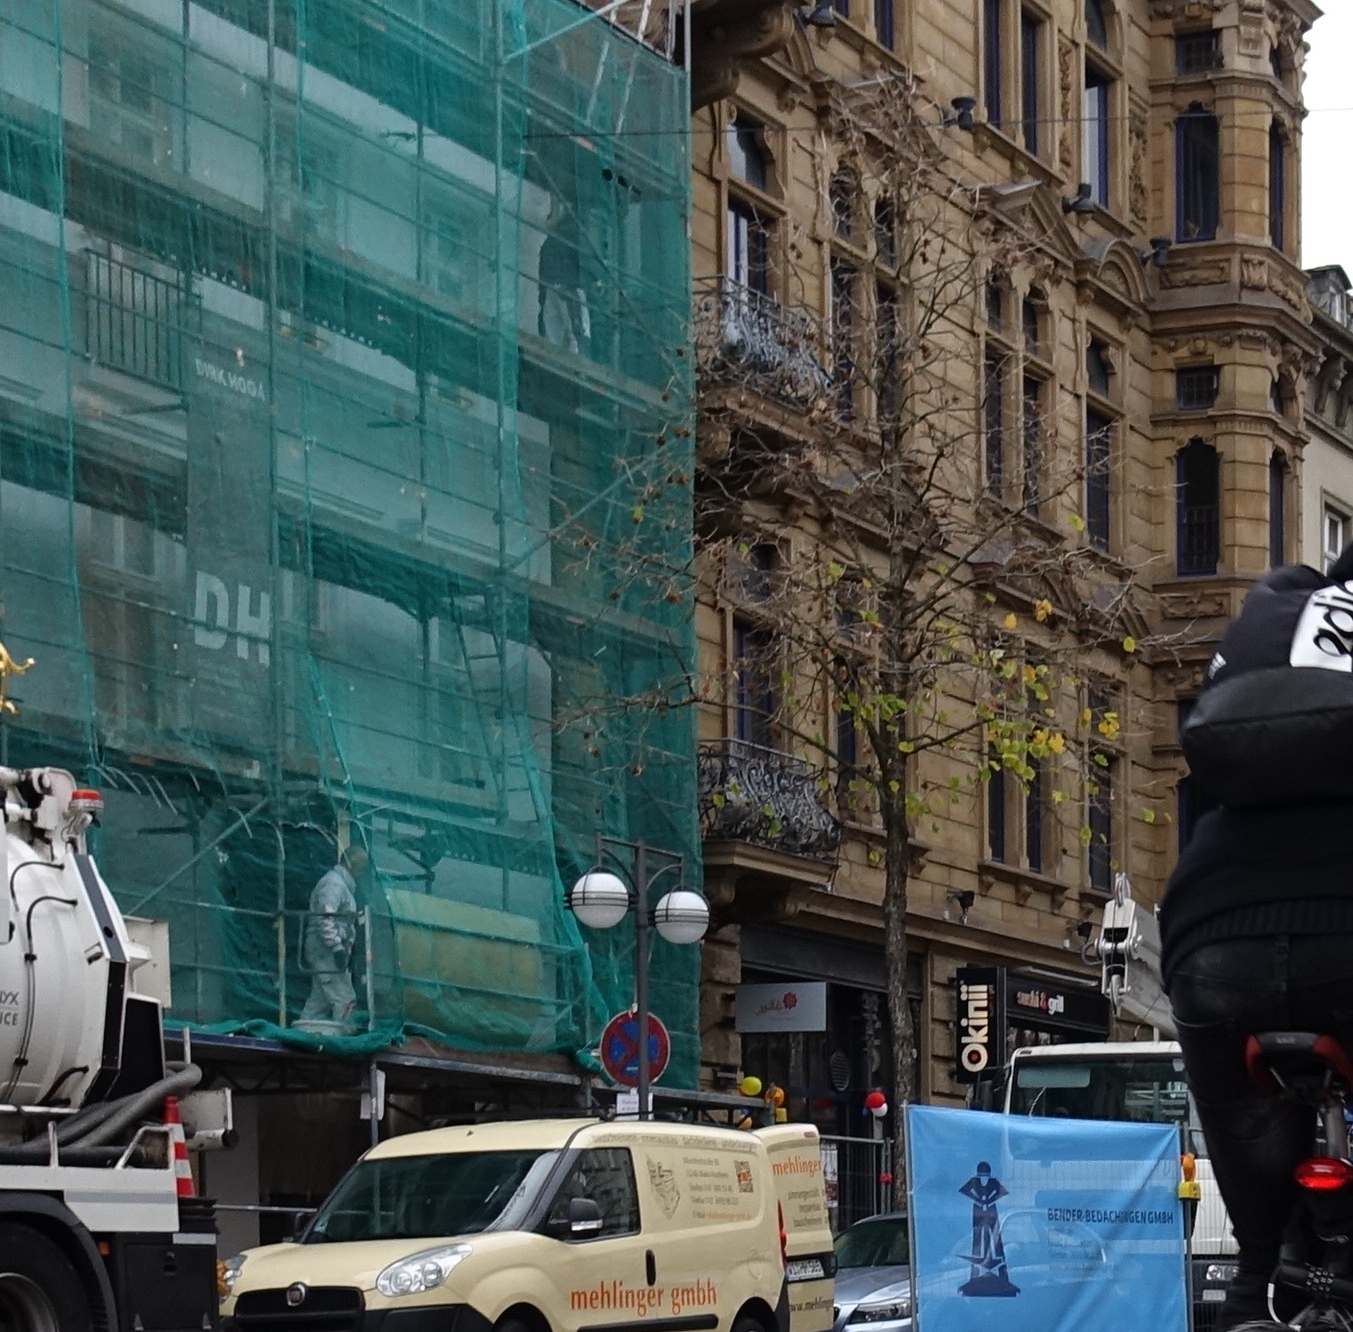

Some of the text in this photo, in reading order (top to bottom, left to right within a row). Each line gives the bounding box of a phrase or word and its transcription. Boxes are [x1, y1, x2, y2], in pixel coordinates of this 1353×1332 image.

[960, 984, 988, 1072] Okinii
[570, 1277, 717, 1317] mehlinger gmbh
